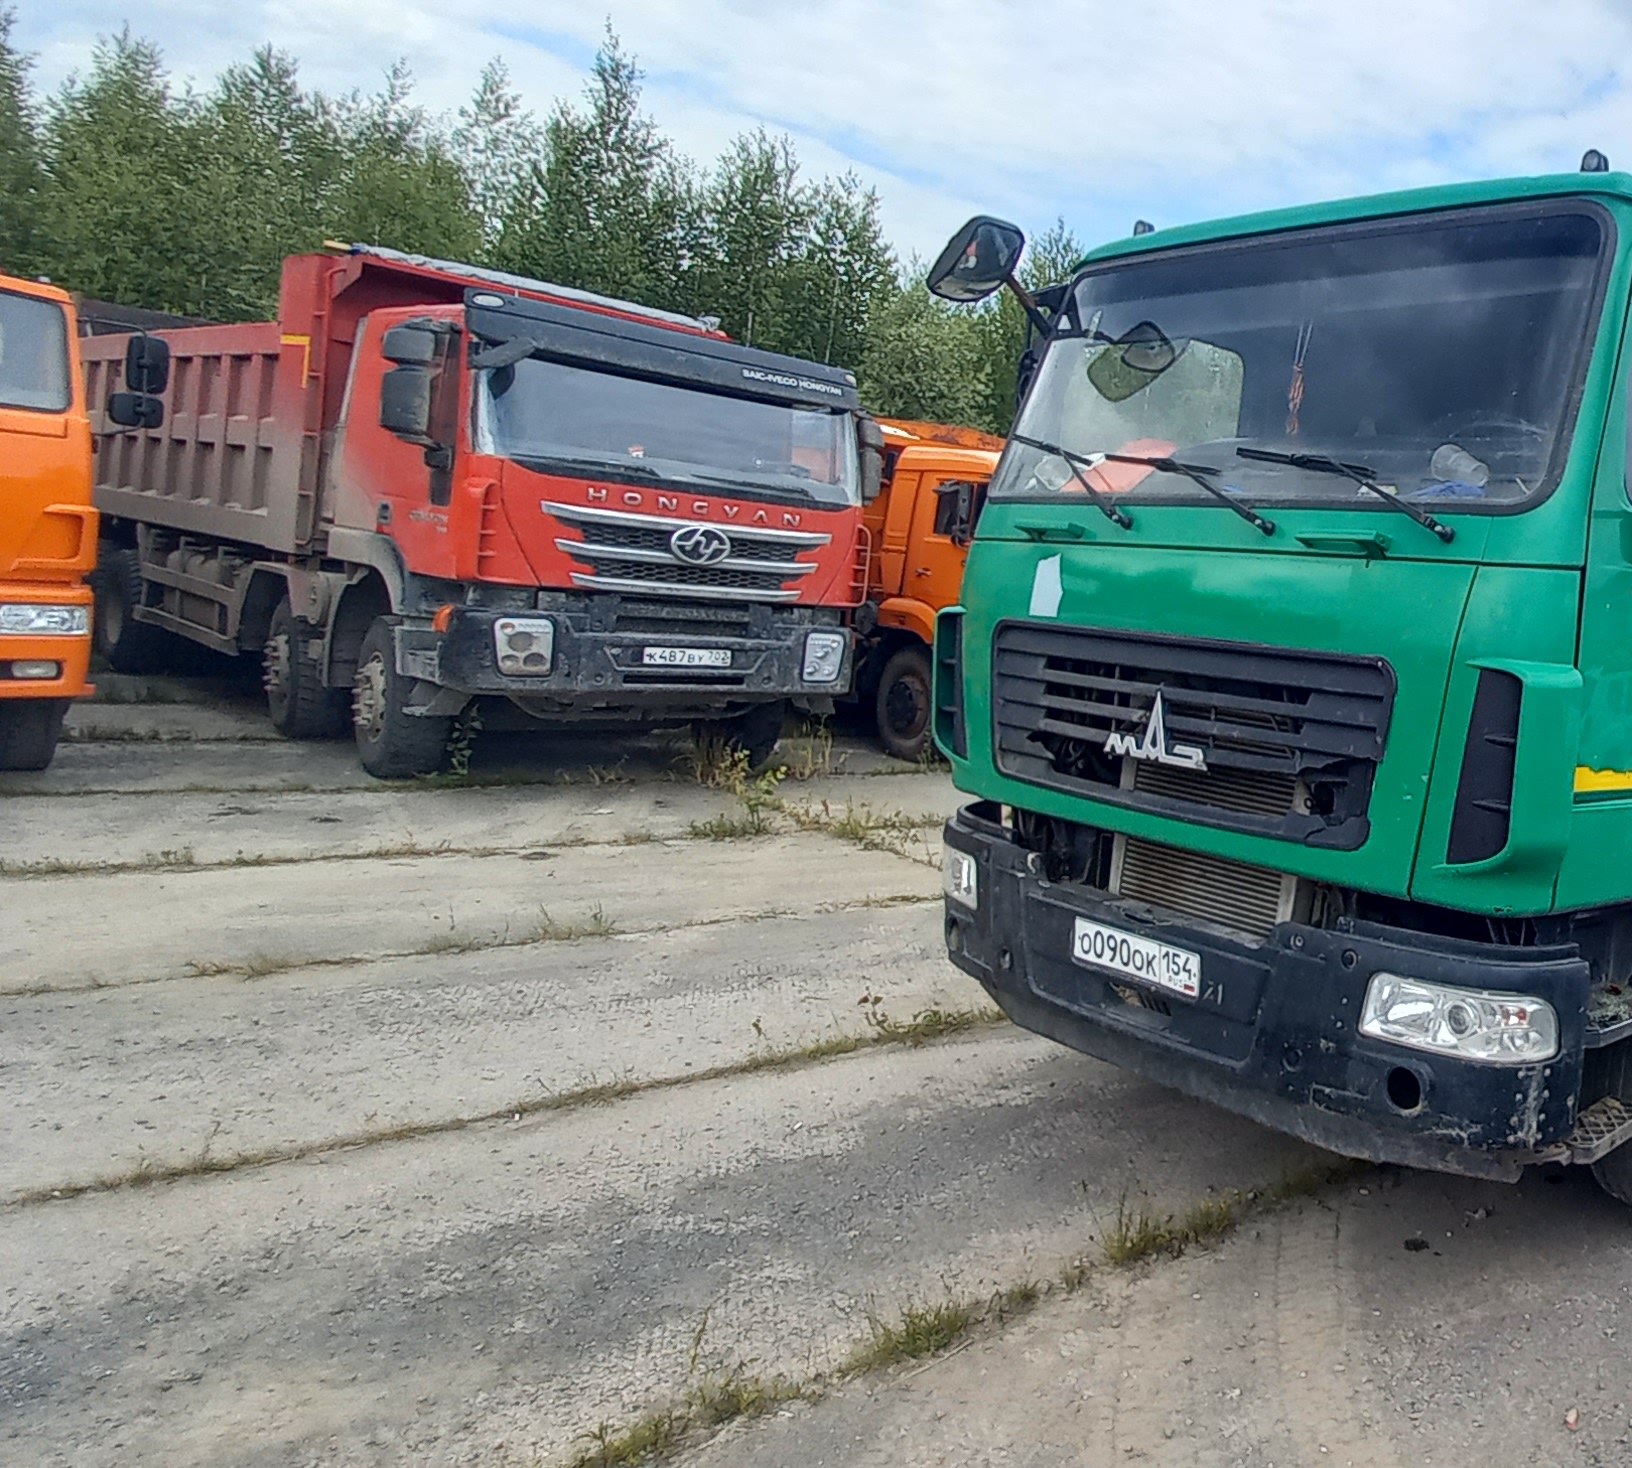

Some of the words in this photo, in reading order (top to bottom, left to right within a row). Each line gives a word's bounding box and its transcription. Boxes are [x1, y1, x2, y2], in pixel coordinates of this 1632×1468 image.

[799, 379, 843, 397] HONGYAN
[586, 486, 801, 528] HONGYAN
[1162, 950, 1192, 981] 154
